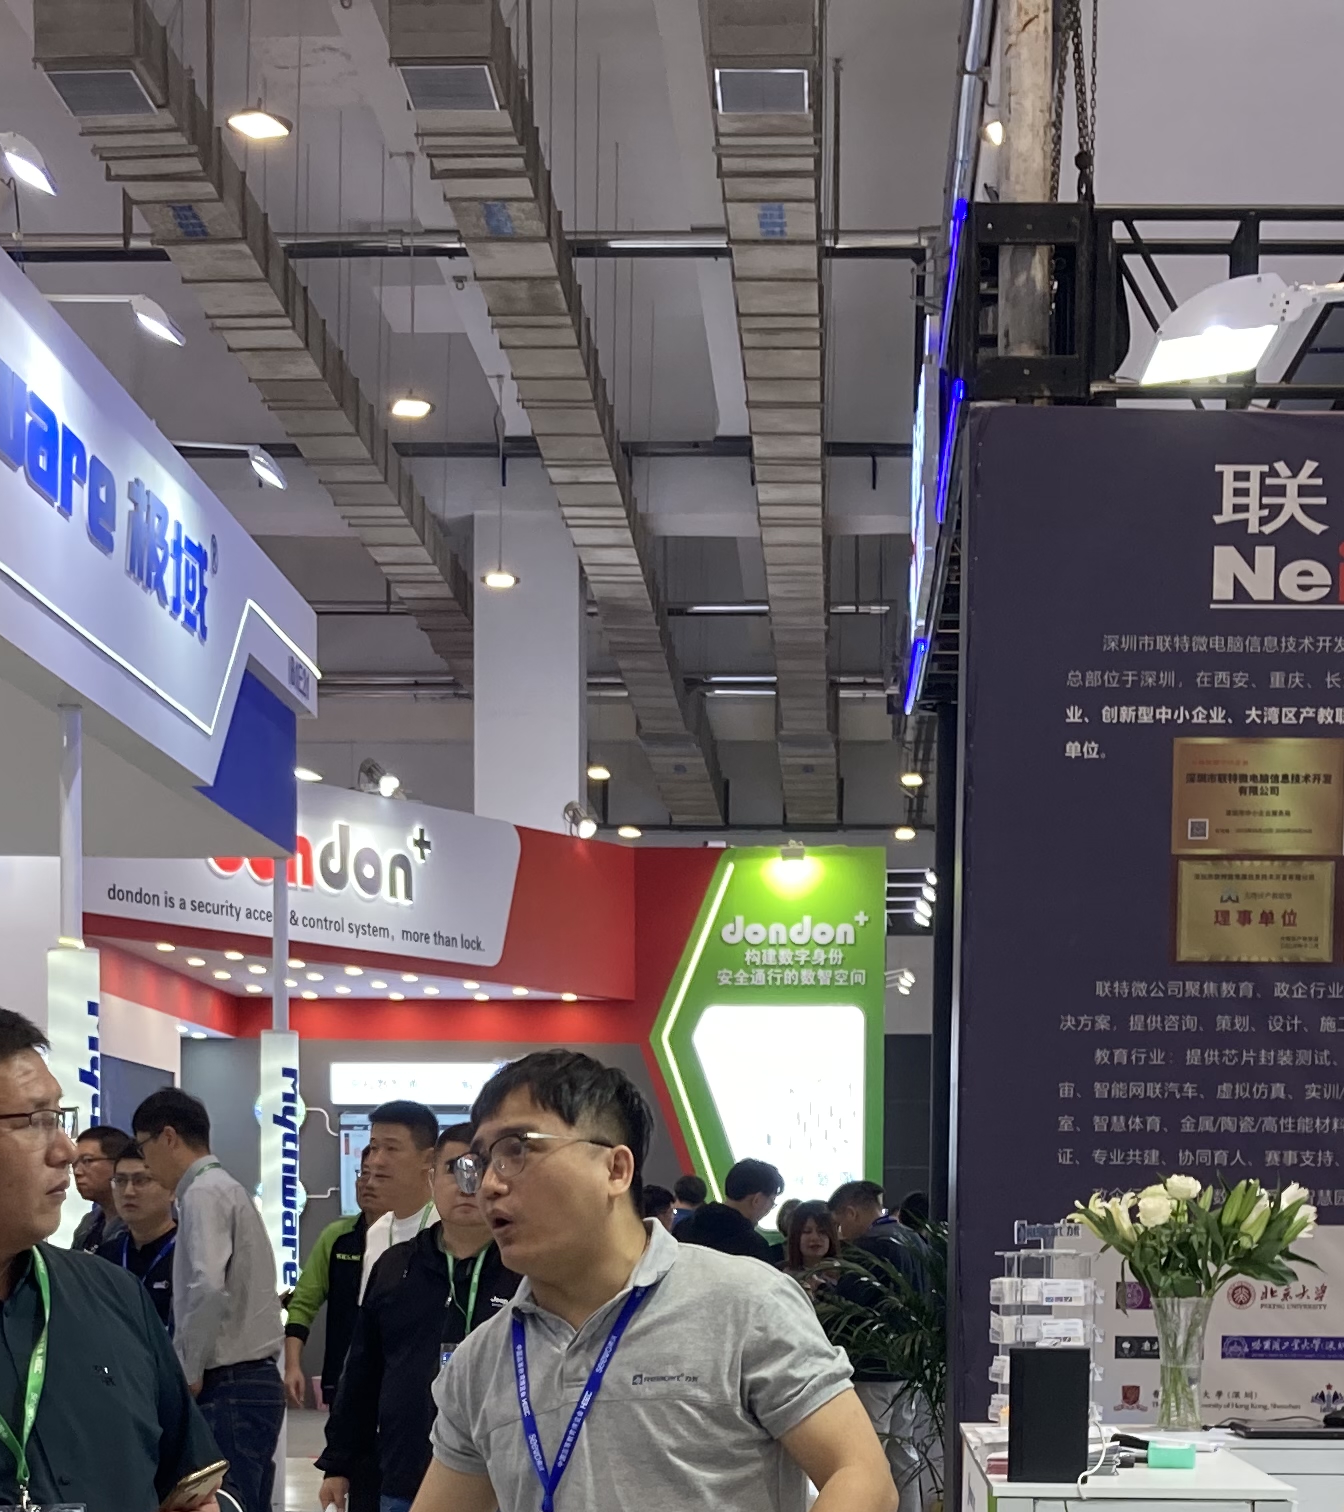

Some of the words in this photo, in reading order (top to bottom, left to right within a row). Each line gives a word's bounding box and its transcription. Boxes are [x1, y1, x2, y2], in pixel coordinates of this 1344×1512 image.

[106, 883, 160, 908] dondon
[163, 890, 175, 909] is
[178, 897, 187, 911] a
[190, 896, 243, 923] security
[244, 905, 274, 924] acce
[289, 910, 299, 926] &
[301, 912, 345, 934] control
[401, 926, 431, 945] more
[432, 928, 459, 948] than
[744, 949, 845, 966] 构建数字身份
[716, 968, 867, 987] 安全通行的数智空间
